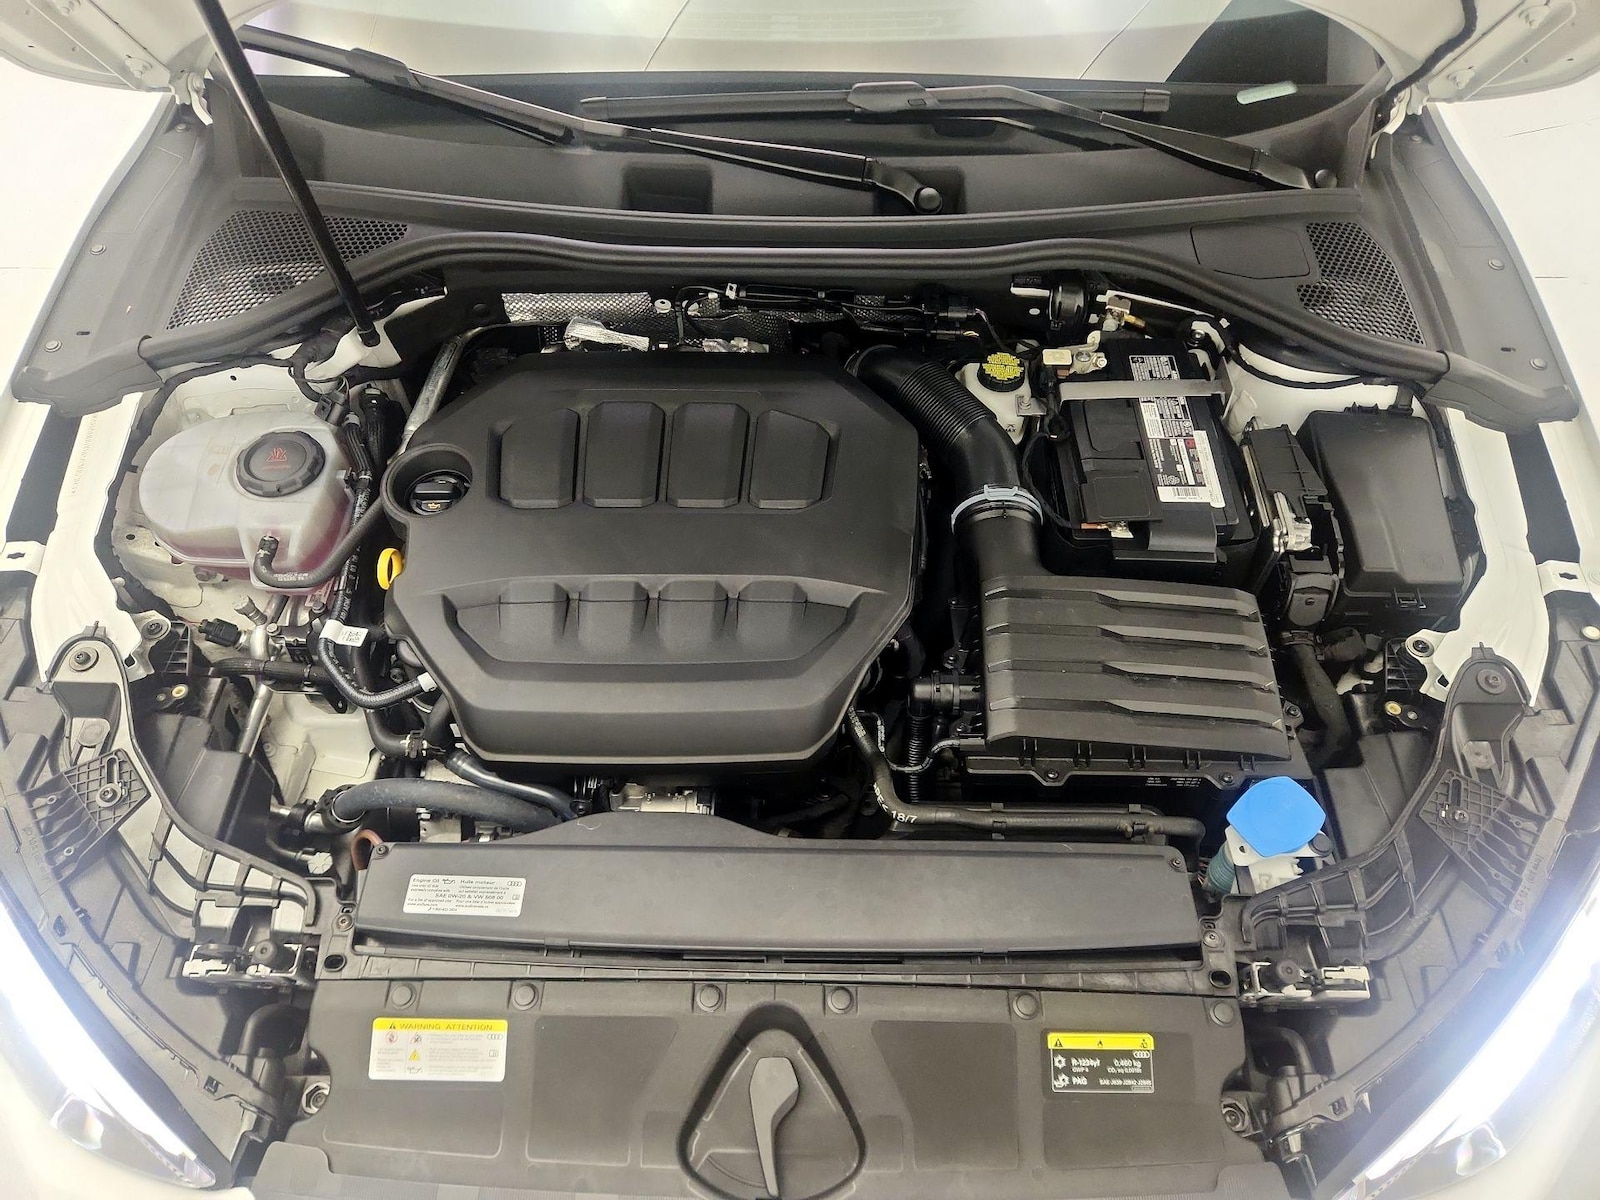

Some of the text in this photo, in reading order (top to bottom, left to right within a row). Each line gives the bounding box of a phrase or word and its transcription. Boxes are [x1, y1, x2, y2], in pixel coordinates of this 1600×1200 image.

[891, 810, 918, 824] 18/7
[1133, 1060, 1142, 1068] kg
[1072, 1076, 1088, 1085] PAG
